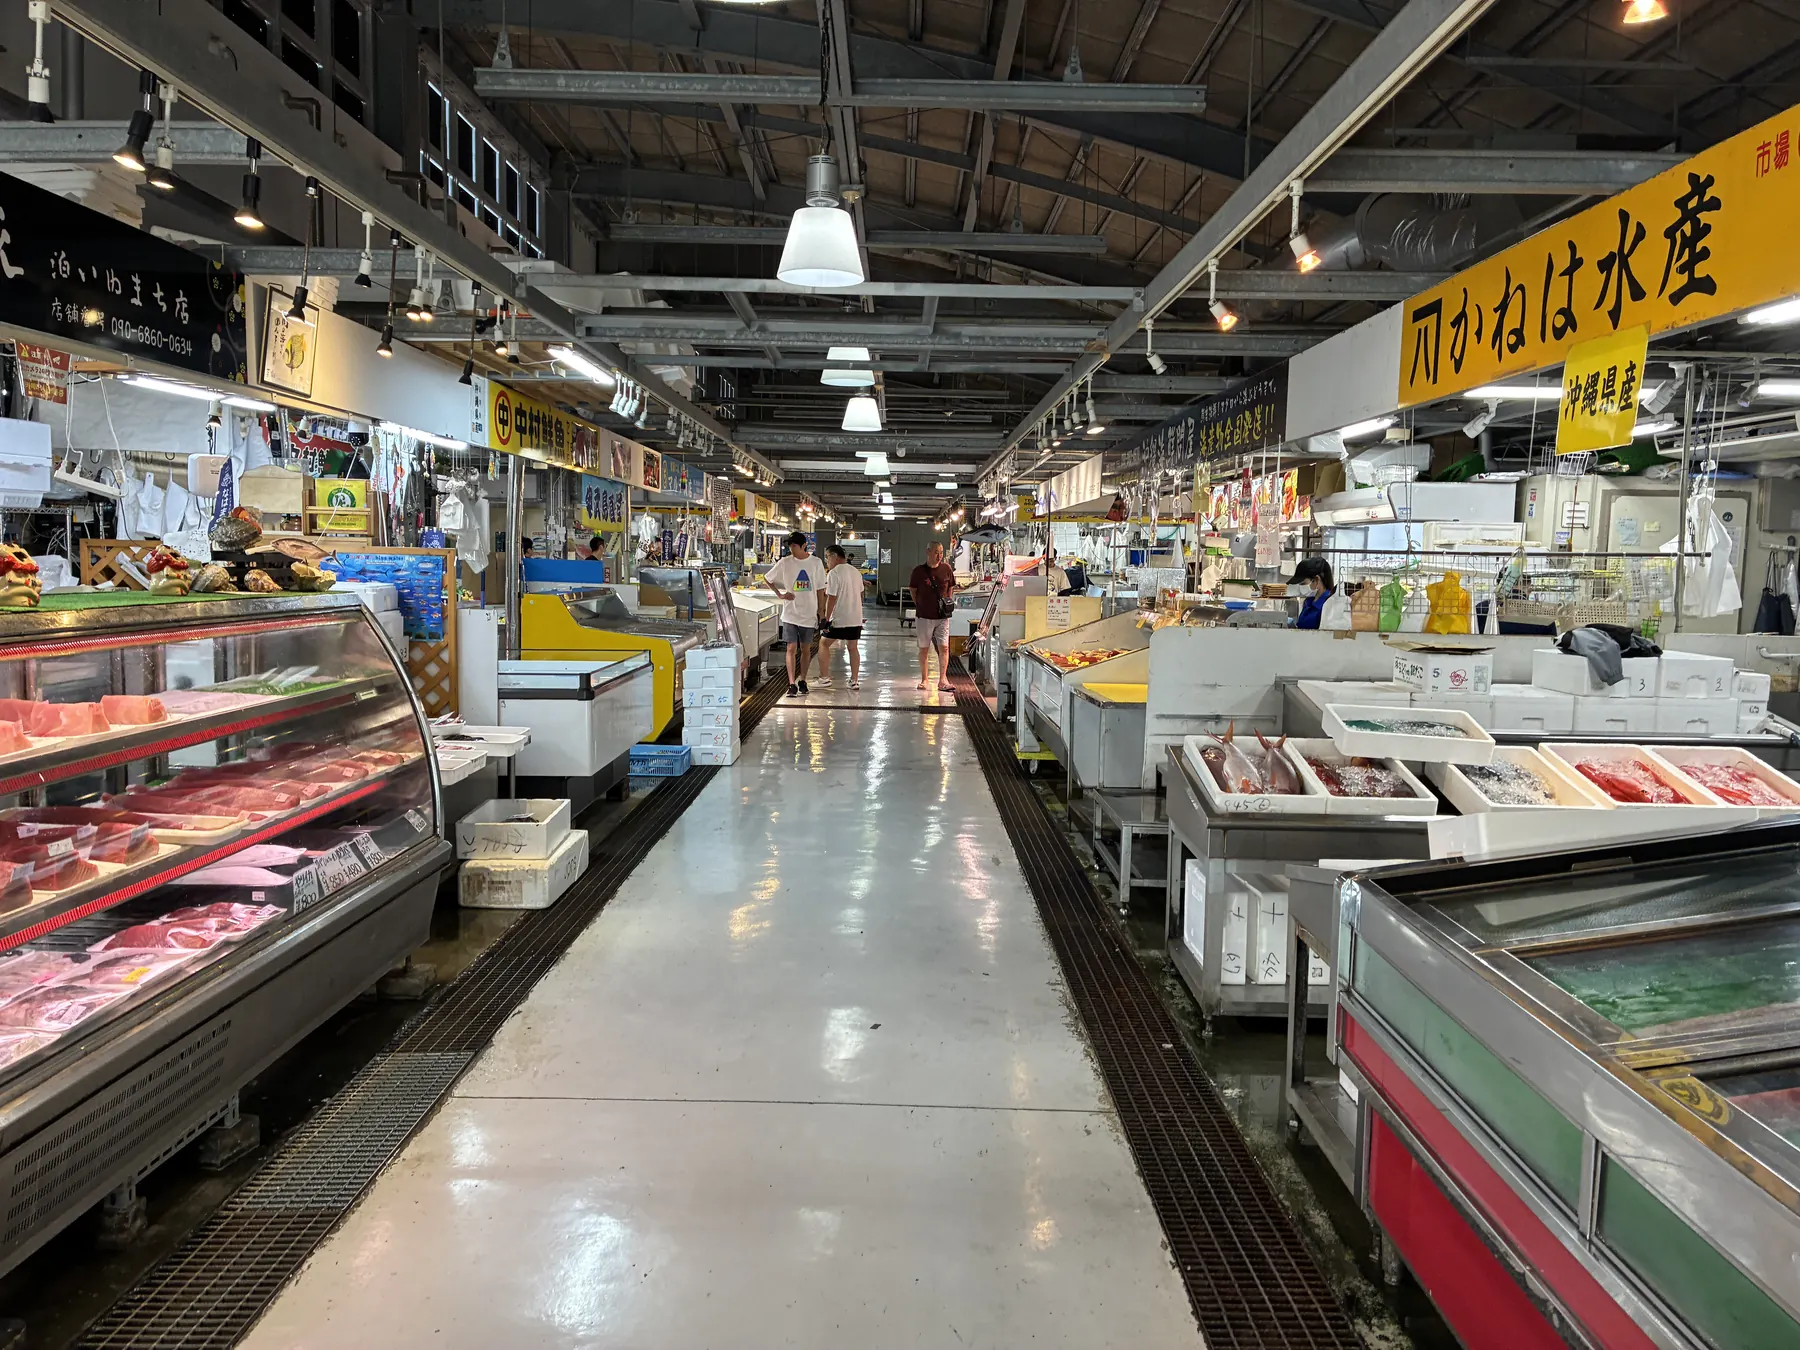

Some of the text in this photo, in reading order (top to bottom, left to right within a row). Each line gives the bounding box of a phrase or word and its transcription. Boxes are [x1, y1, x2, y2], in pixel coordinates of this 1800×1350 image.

[1756, 129, 1800, 178] 市場
[49, 250, 190, 325] 泊いゆまち店
[111, 316, 193, 357] 090-6860-0634
[1564, 360, 1637, 423] 沖縄県産
[514, 402, 565, 460] 中村鮮魚
[1432, 668, 1440, 678] 5
[1638, 678, 1646, 692] 3
